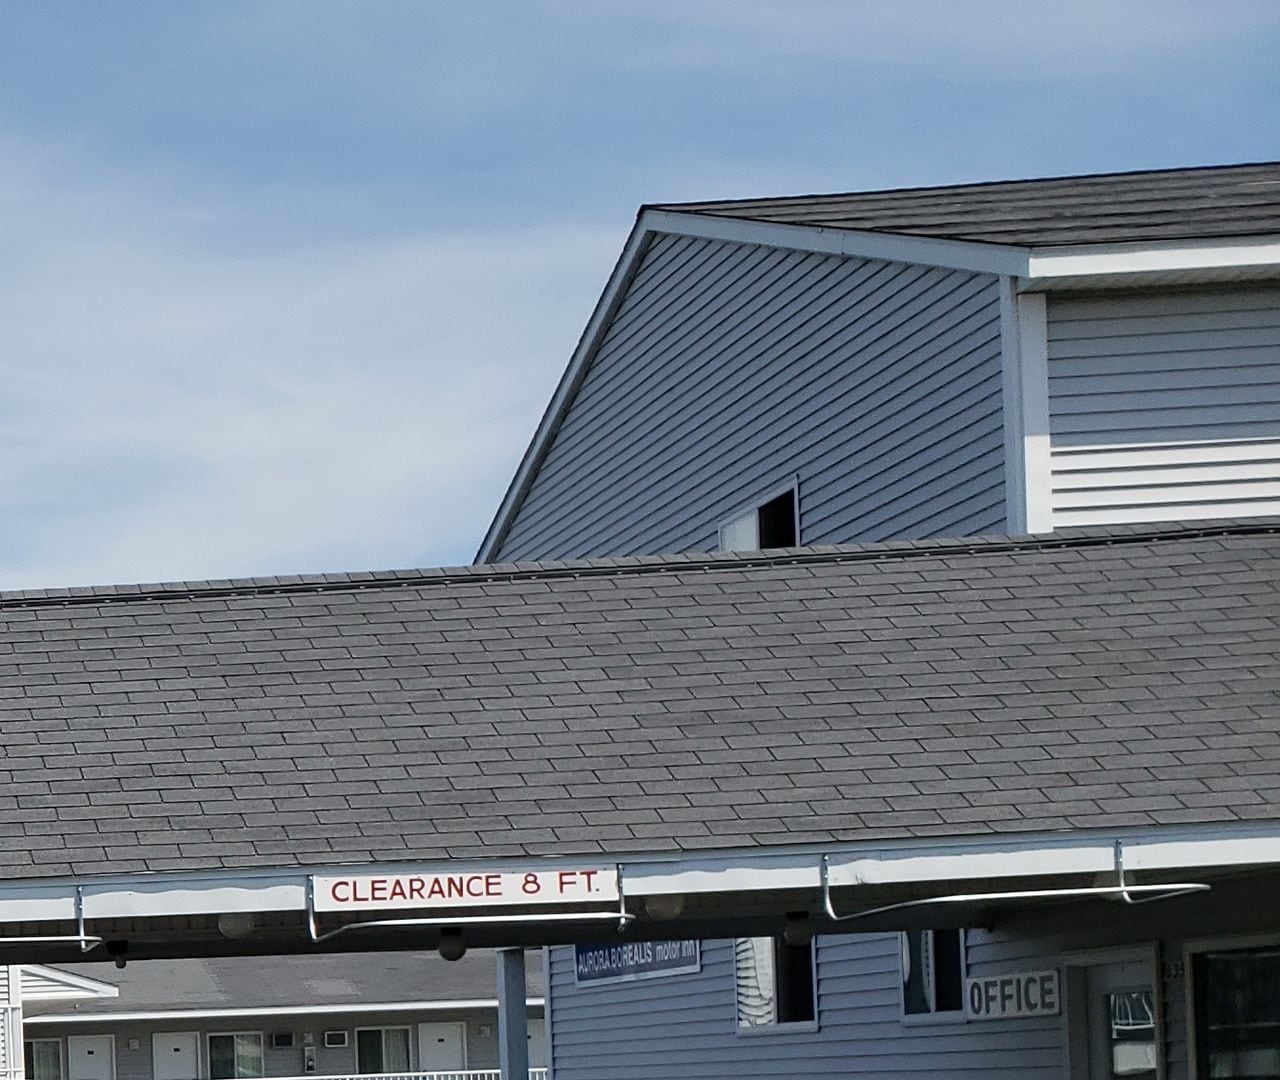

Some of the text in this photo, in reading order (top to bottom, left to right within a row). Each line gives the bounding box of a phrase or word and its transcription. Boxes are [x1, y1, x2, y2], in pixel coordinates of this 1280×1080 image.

[331, 870, 600, 902] CLEARANCE 8 FT.
[578, 950, 611, 973] AURORA
[611, 941, 652, 968] BOREALIS
[656, 940, 680, 961] motor
[970, 975, 1056, 1015] OFFICE
